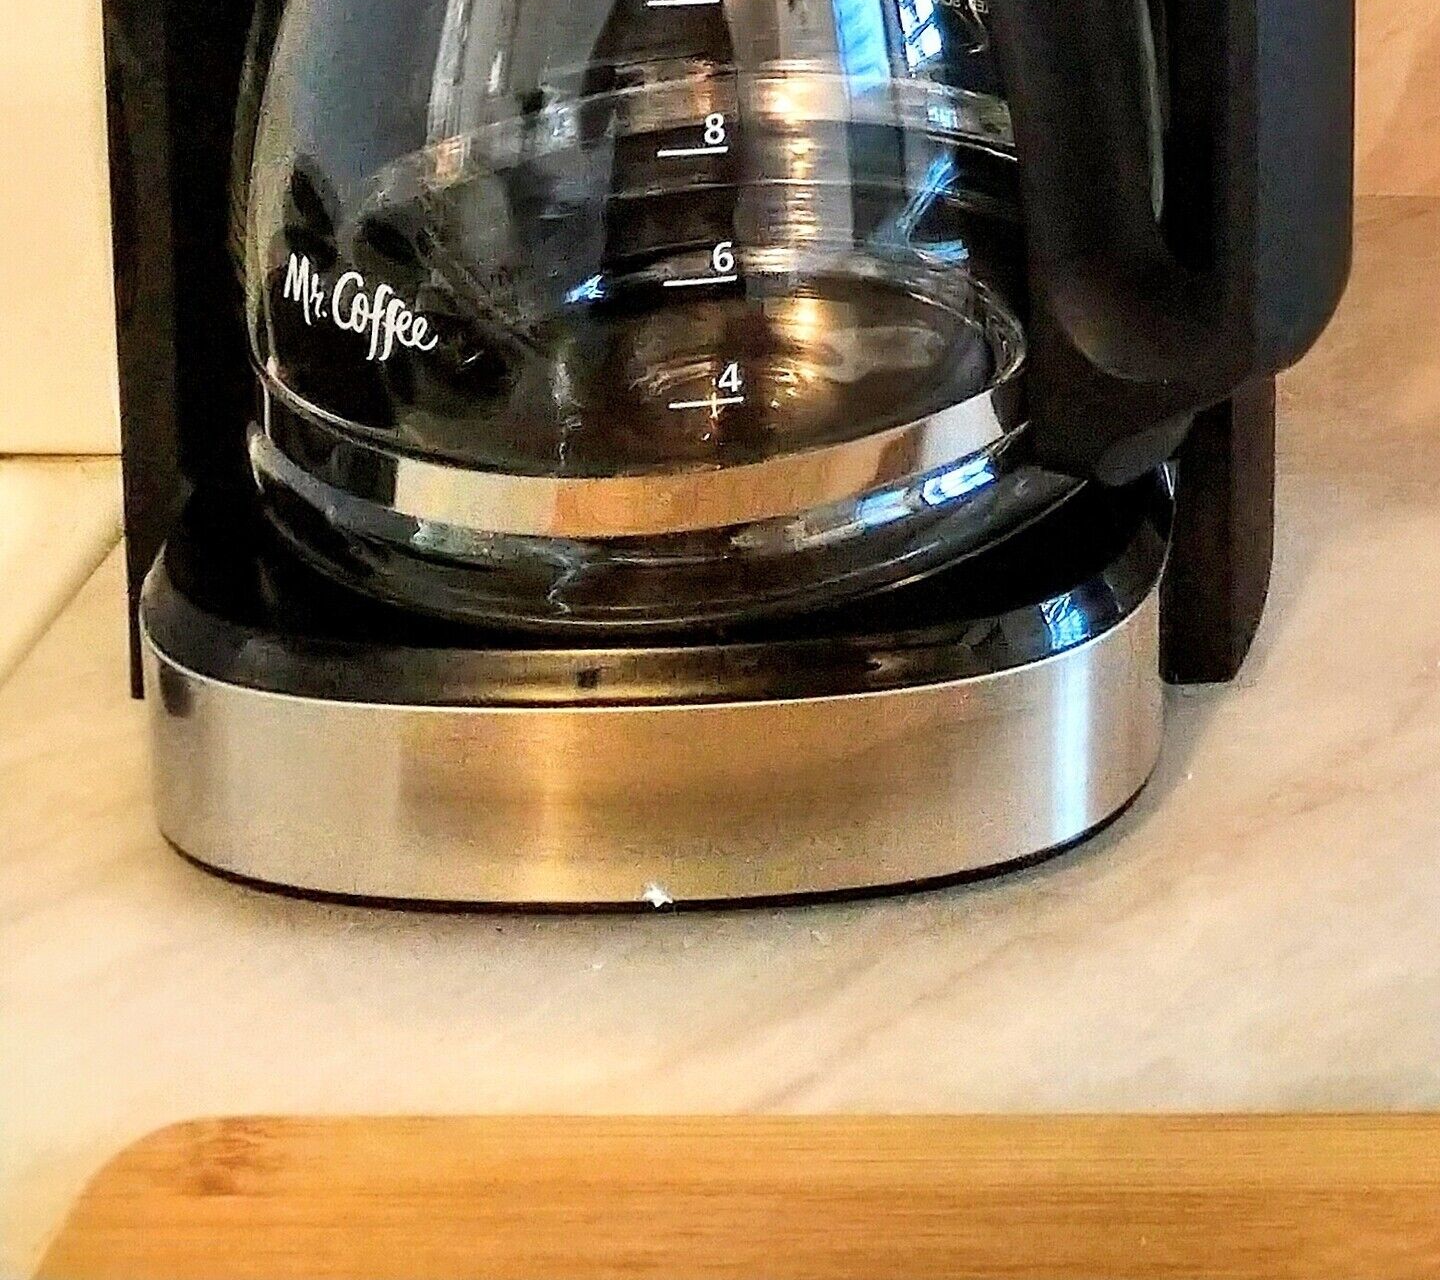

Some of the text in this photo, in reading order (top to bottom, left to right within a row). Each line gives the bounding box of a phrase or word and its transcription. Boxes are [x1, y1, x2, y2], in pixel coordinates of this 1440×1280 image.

[703, 113, 726, 146] 8
[712, 240, 735, 274] 6
[283, 252, 439, 361] Mr. Coffee
[717, 361, 742, 395] 4
